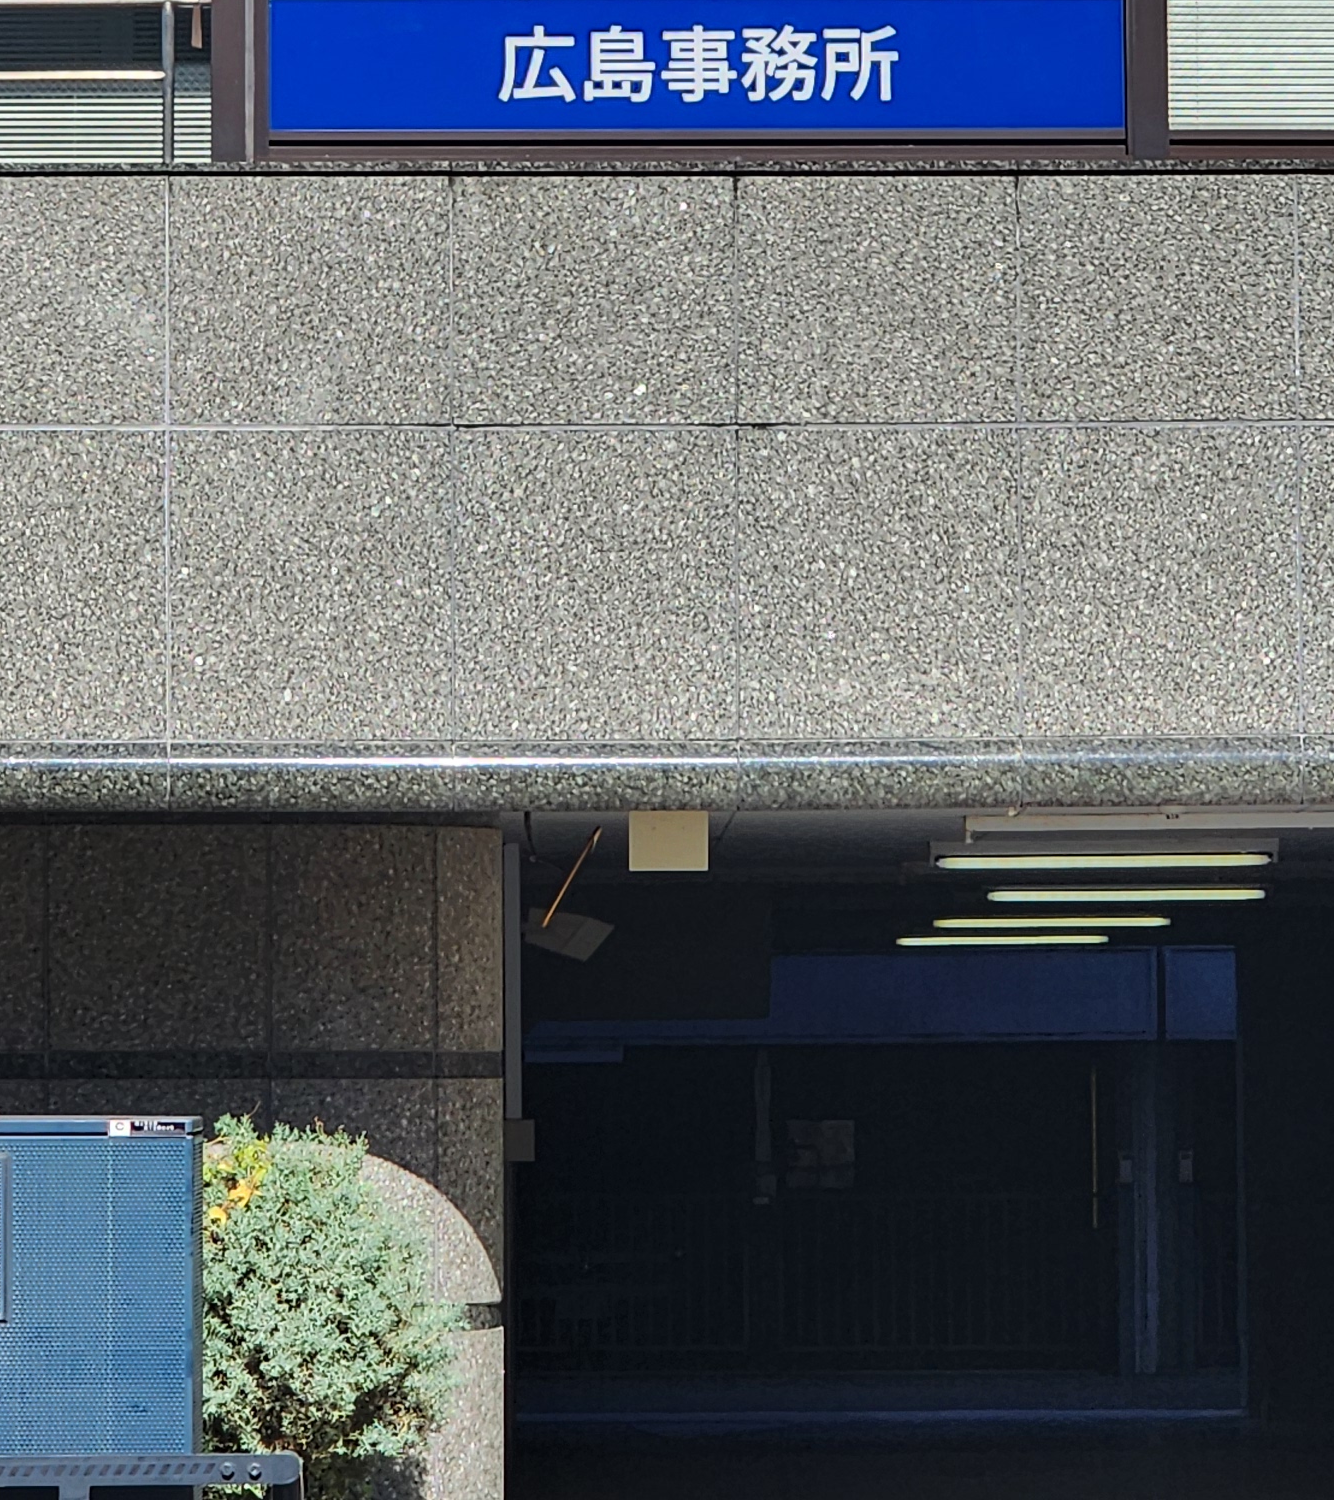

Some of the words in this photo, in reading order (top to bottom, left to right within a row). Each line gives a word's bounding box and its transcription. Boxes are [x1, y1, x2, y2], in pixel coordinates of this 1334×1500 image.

[498, 24, 900, 103] 広島事務所
